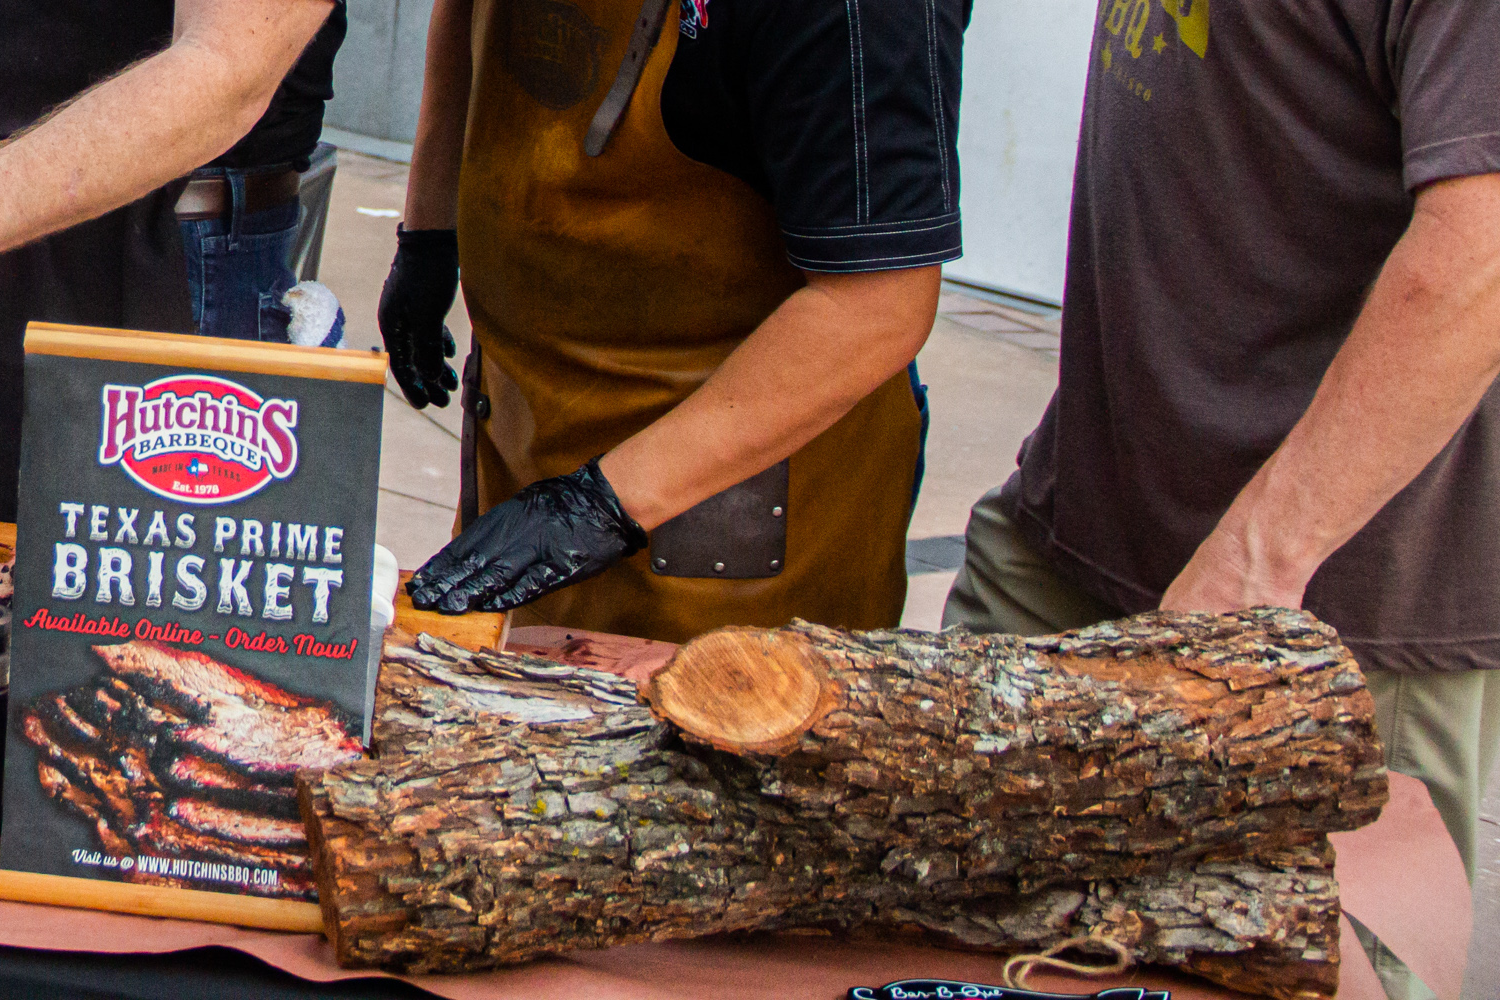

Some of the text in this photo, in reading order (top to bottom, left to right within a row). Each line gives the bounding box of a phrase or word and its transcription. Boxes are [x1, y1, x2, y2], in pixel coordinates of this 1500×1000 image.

[138, 433, 258, 466] BARBEQUE
[172, 481, 219, 495] Est. 1978
[212, 466, 242, 482] TEXAS
[59, 502, 345, 564] TEXAS PRIME
[51, 542, 344, 624] BRISKET
[24, 608, 131, 638] Available
[135, 618, 204, 645] Online
[225, 627, 289, 654] Order
[293, 634, 358, 660] Now!
[71, 848, 279, 886] Visit us @ WWW.HUTCHINSBBQ.COM
